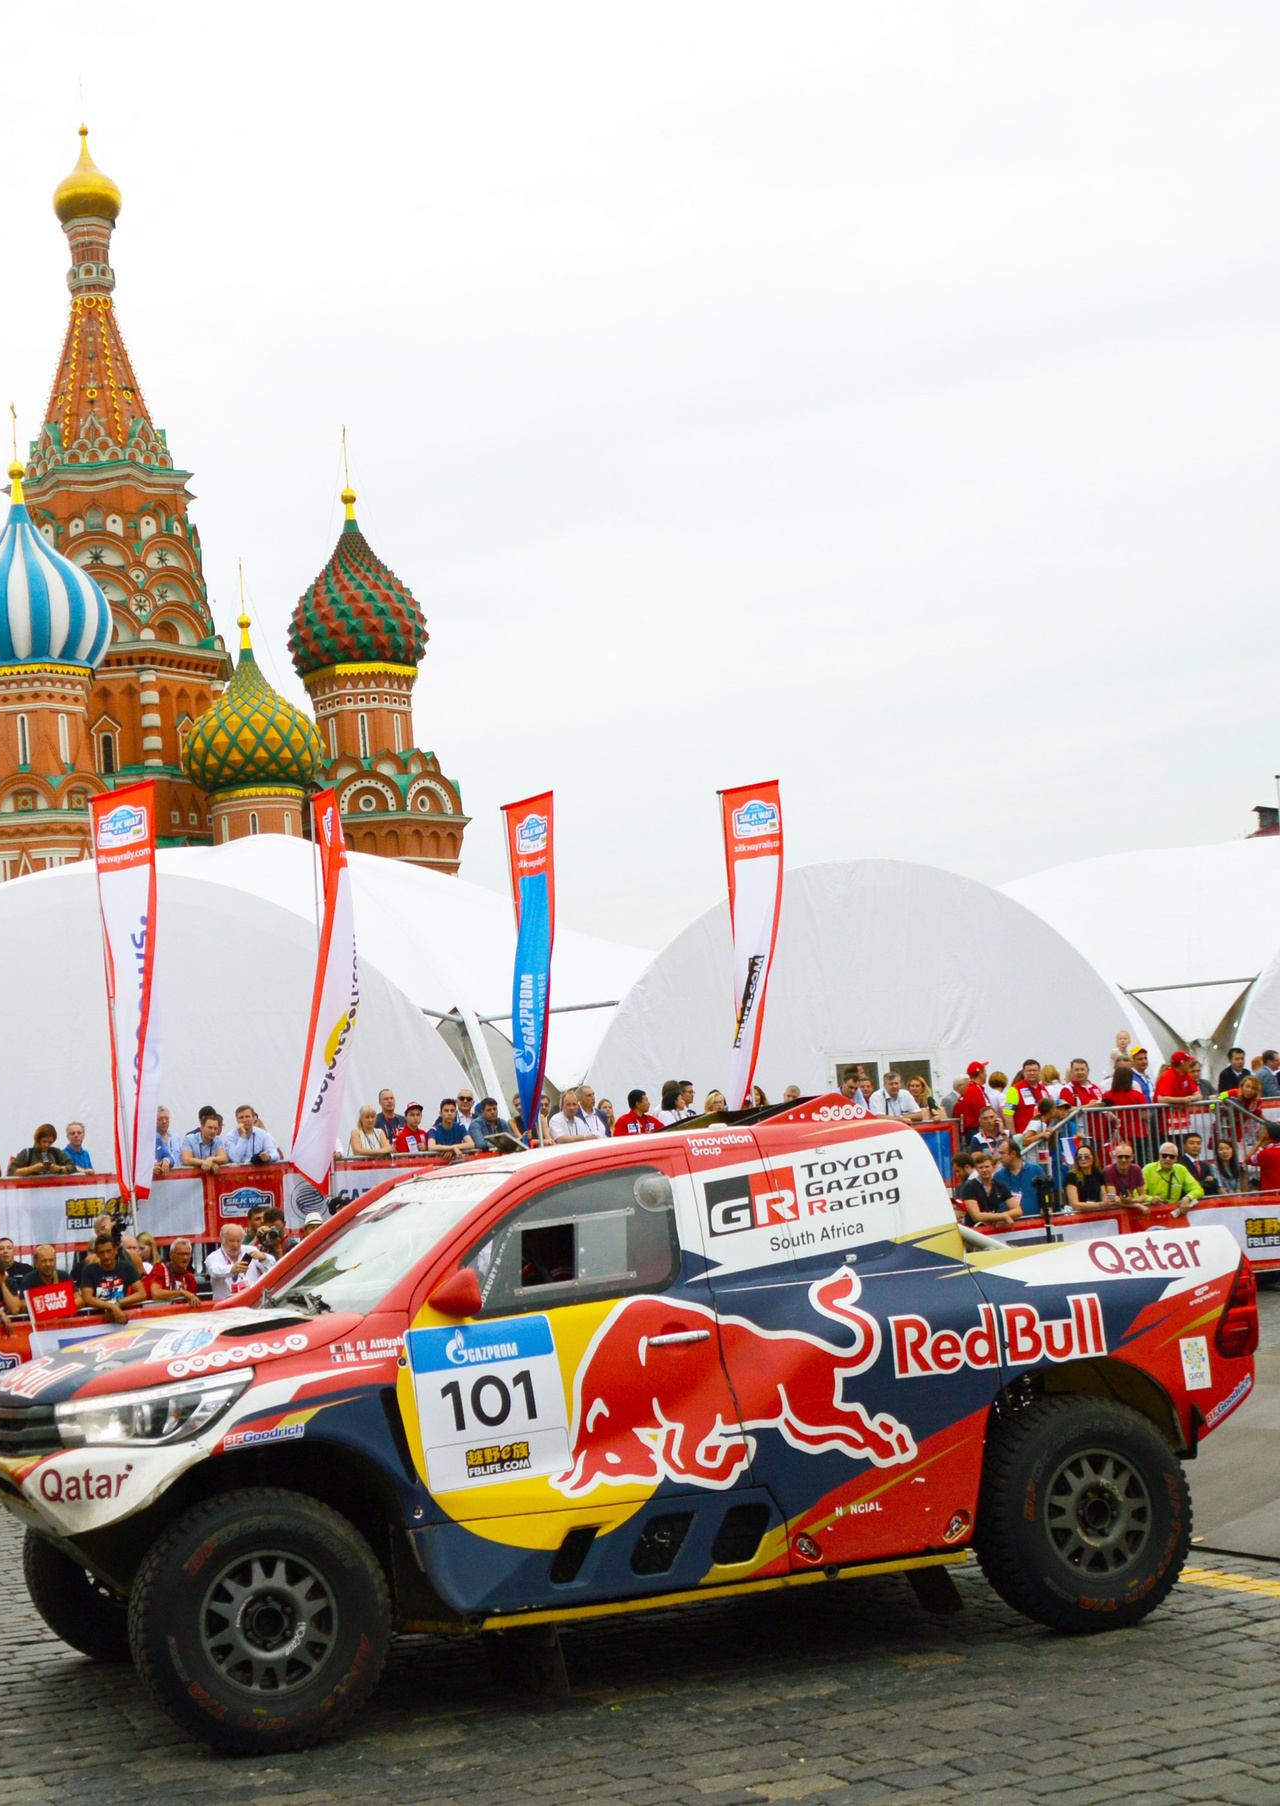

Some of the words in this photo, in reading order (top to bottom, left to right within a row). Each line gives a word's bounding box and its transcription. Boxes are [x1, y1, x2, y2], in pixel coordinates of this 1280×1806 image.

[102, 821, 123, 832] SILK
[123, 815, 141, 826] WAY
[98, 847, 151, 864] silkwayrally.com
[519, 974, 535, 1046] GAZPROM
[691, 1147, 721, 1156] Group
[801, 1149, 903, 1178] TOYOTA
[805, 1167, 898, 1197] GAZOO
[225, 1197, 247, 1205] SILK
[248, 1196, 269, 1204] WAY
[709, 1189, 797, 1234] GR
[808, 1187, 900, 1216] Racing
[770, 1228, 815, 1251] South
[820, 1222, 865, 1242] Africa
[1088, 1237, 1201, 1275] Qatar
[44, 1290, 66, 1302] SILK
[45, 1299, 68, 1311] WAY
[344, 1342, 354, 1352] N.
[356, 1341, 367, 1351] Al
[370, 1336, 405, 1349] Attiyah
[890, 1304, 1000, 1378] Red
[1000, 1293, 1107, 1367] Bull
[346, 1352, 359, 1362] M.
[360, 1348, 398, 1361] Baumel
[468, 1342, 518, 1363] GAZPROM
[440, 1369, 538, 1431] 101
[1205, 1373, 1253, 1425] BFGoodrich
[224, 1422, 304, 1448] BFGoodrich
[465, 1441, 530, 1466] 越野e族
[468, 1459, 530, 1478] FBLIFE.COM
[39, 1465, 133, 1503] Qatar
